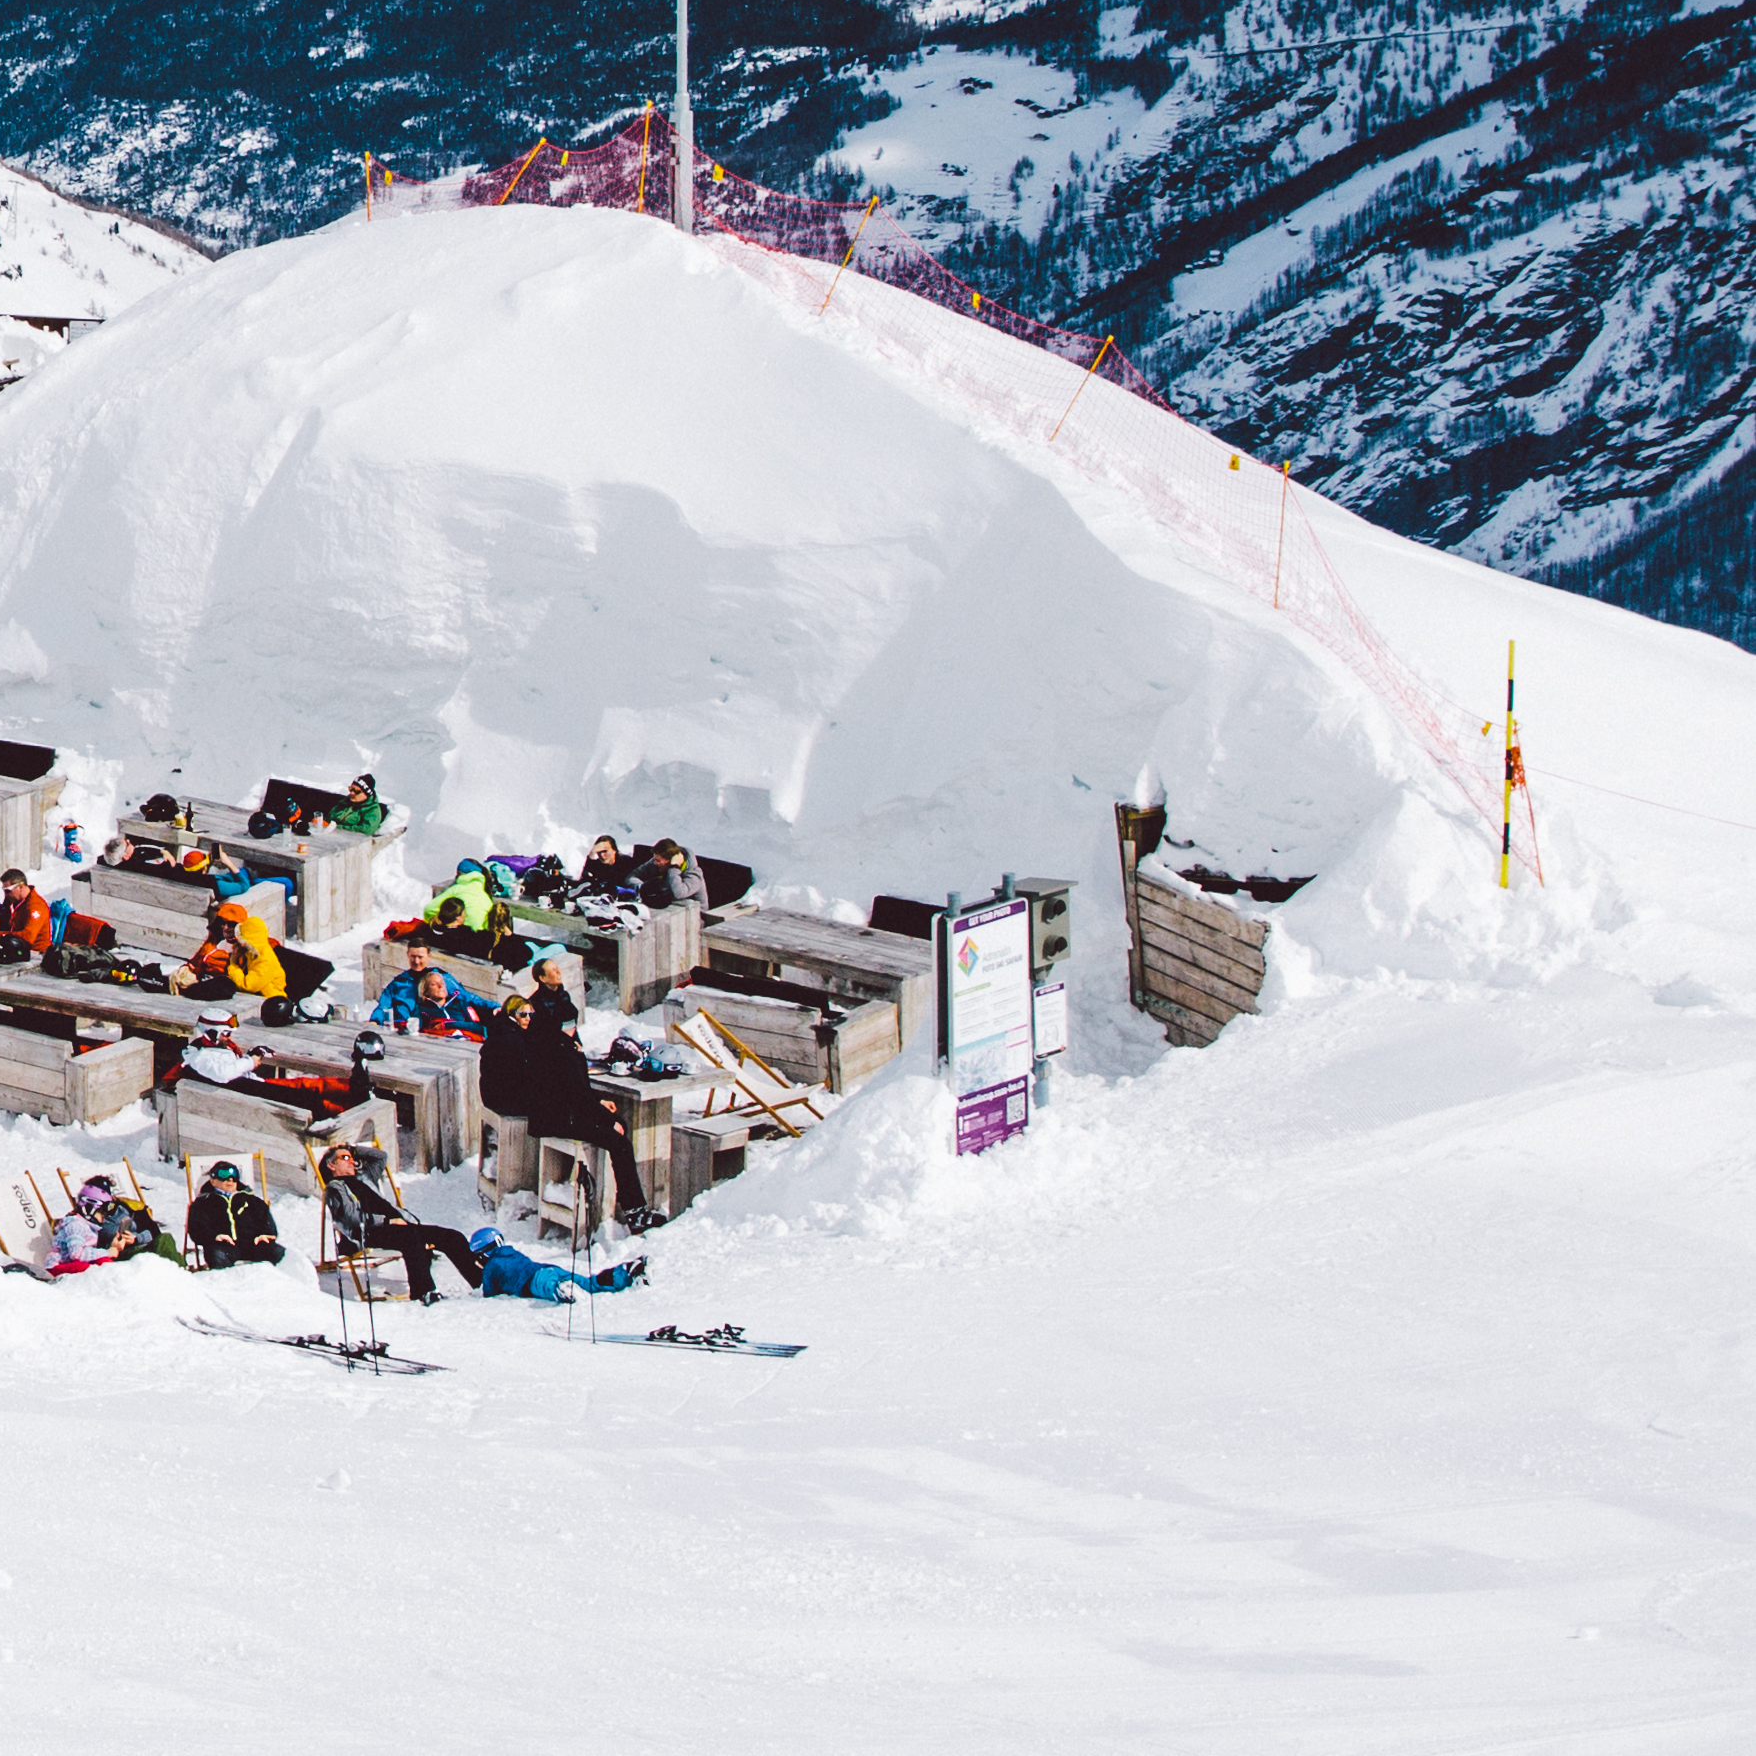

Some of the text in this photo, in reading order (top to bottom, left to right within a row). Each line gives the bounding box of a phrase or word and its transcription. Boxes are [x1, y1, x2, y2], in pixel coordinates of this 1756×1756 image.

[968, 905, 1011, 927] GET YOUR PHOTO
